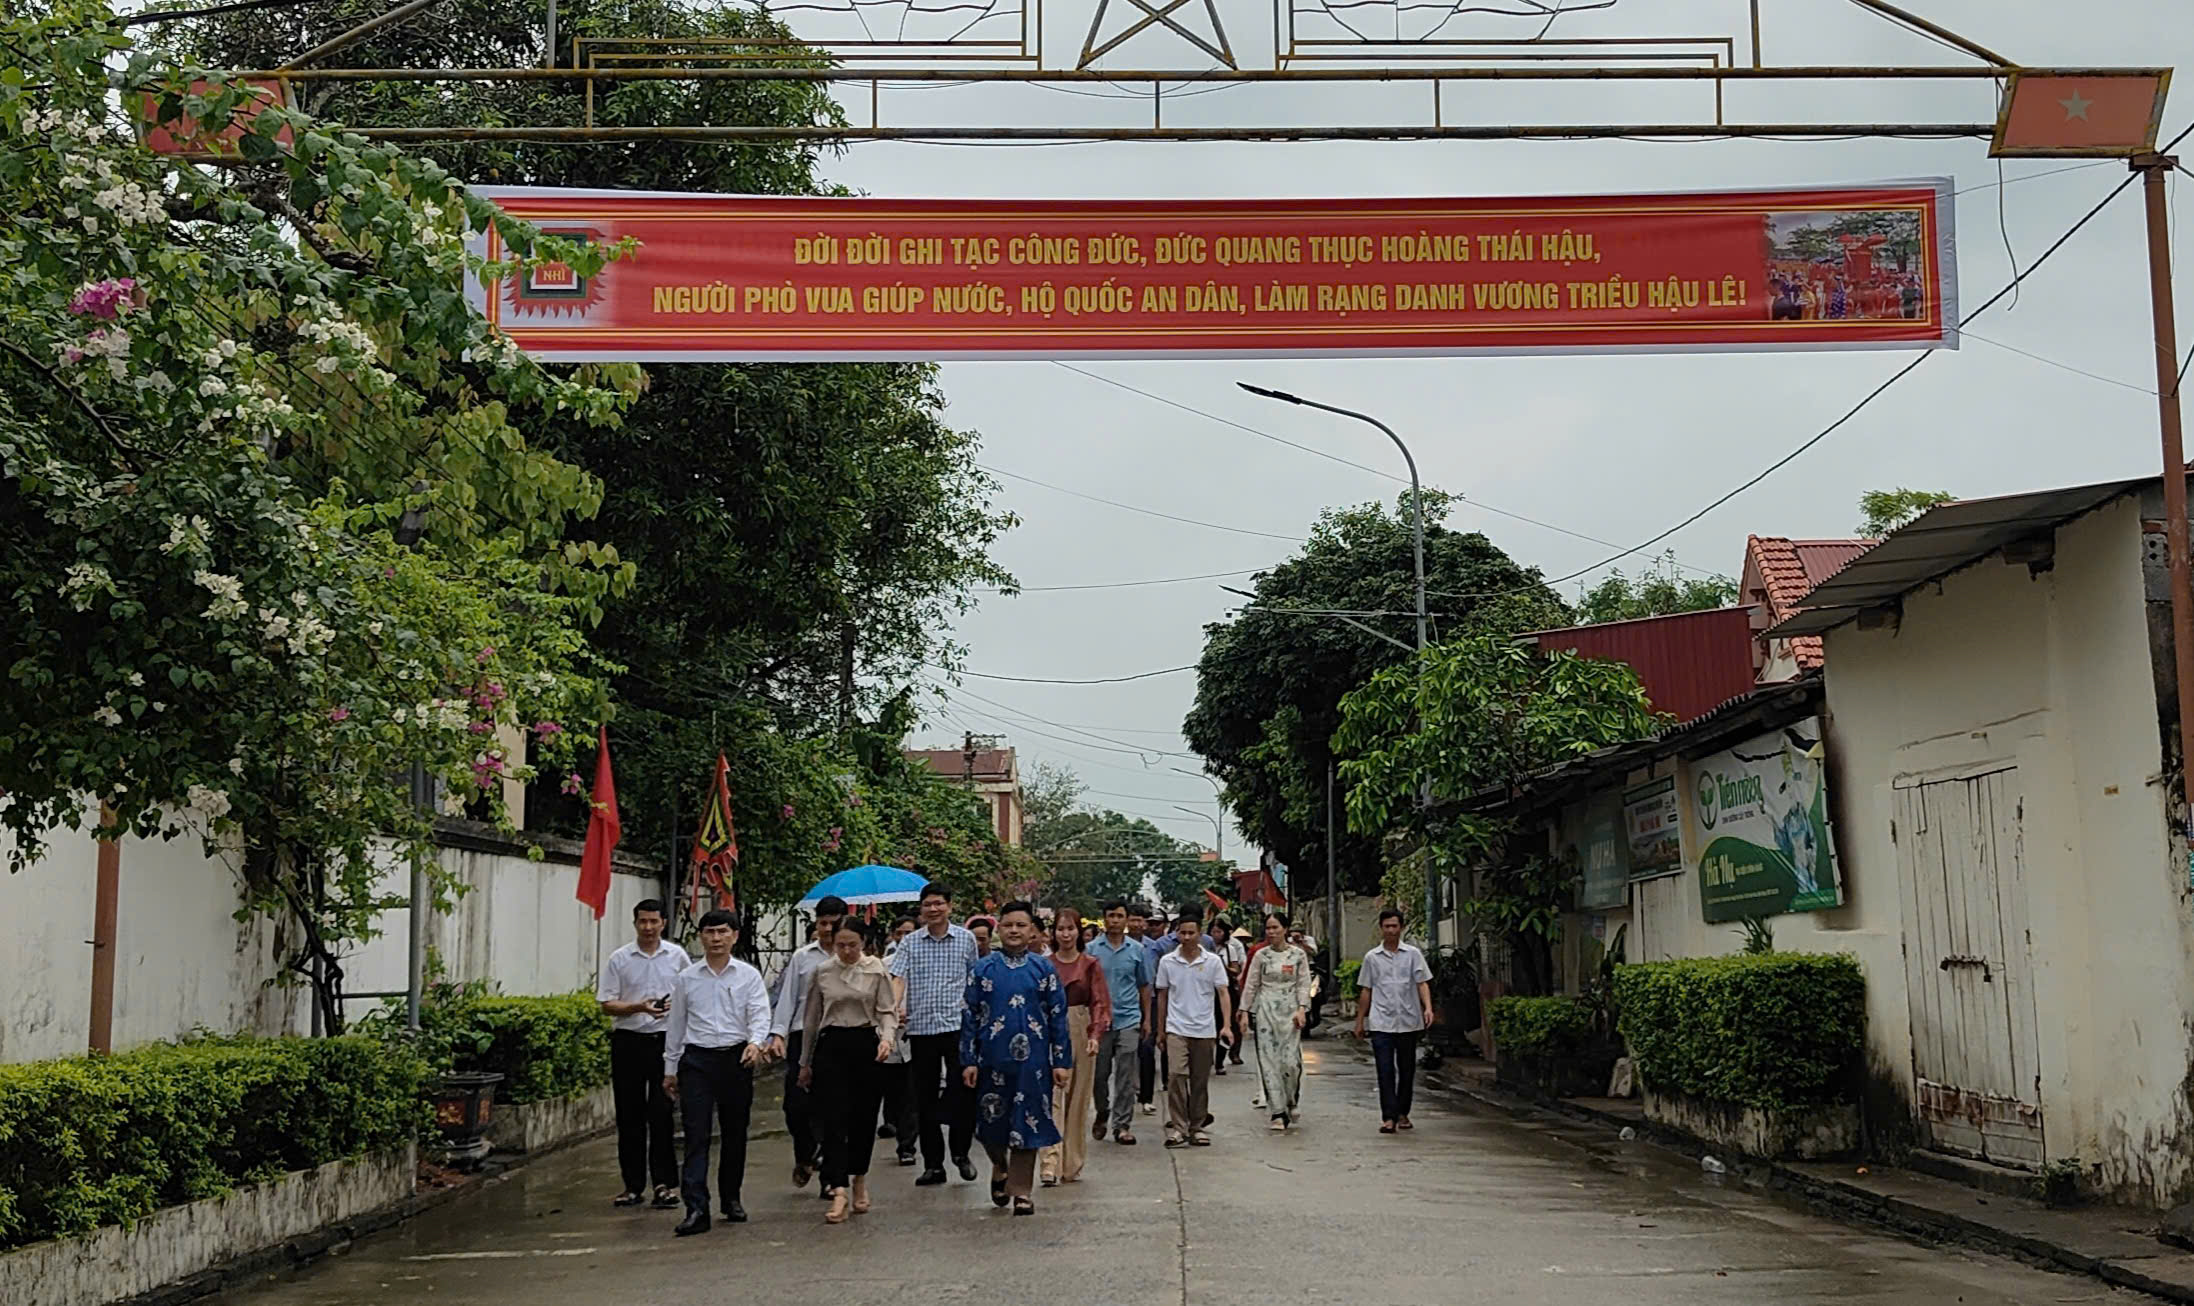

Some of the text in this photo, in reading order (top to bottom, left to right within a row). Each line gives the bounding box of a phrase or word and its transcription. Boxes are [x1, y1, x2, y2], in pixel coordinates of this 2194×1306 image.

[794, 229, 1601, 270] ĐỜI ĐỜI GHI TẠC CÔNG ĐỨC, ĐỨC QUANG THỤC HOÀNG THÁI HẬU,
[653, 273, 1746, 317] NGƯỜI PHÒ VUA GIÚP NƯỚC, HỘ QUỐC AN DÂN, LÀM RẠNG DANH VƯƠNG TRIỀU HẬU LÊ!
